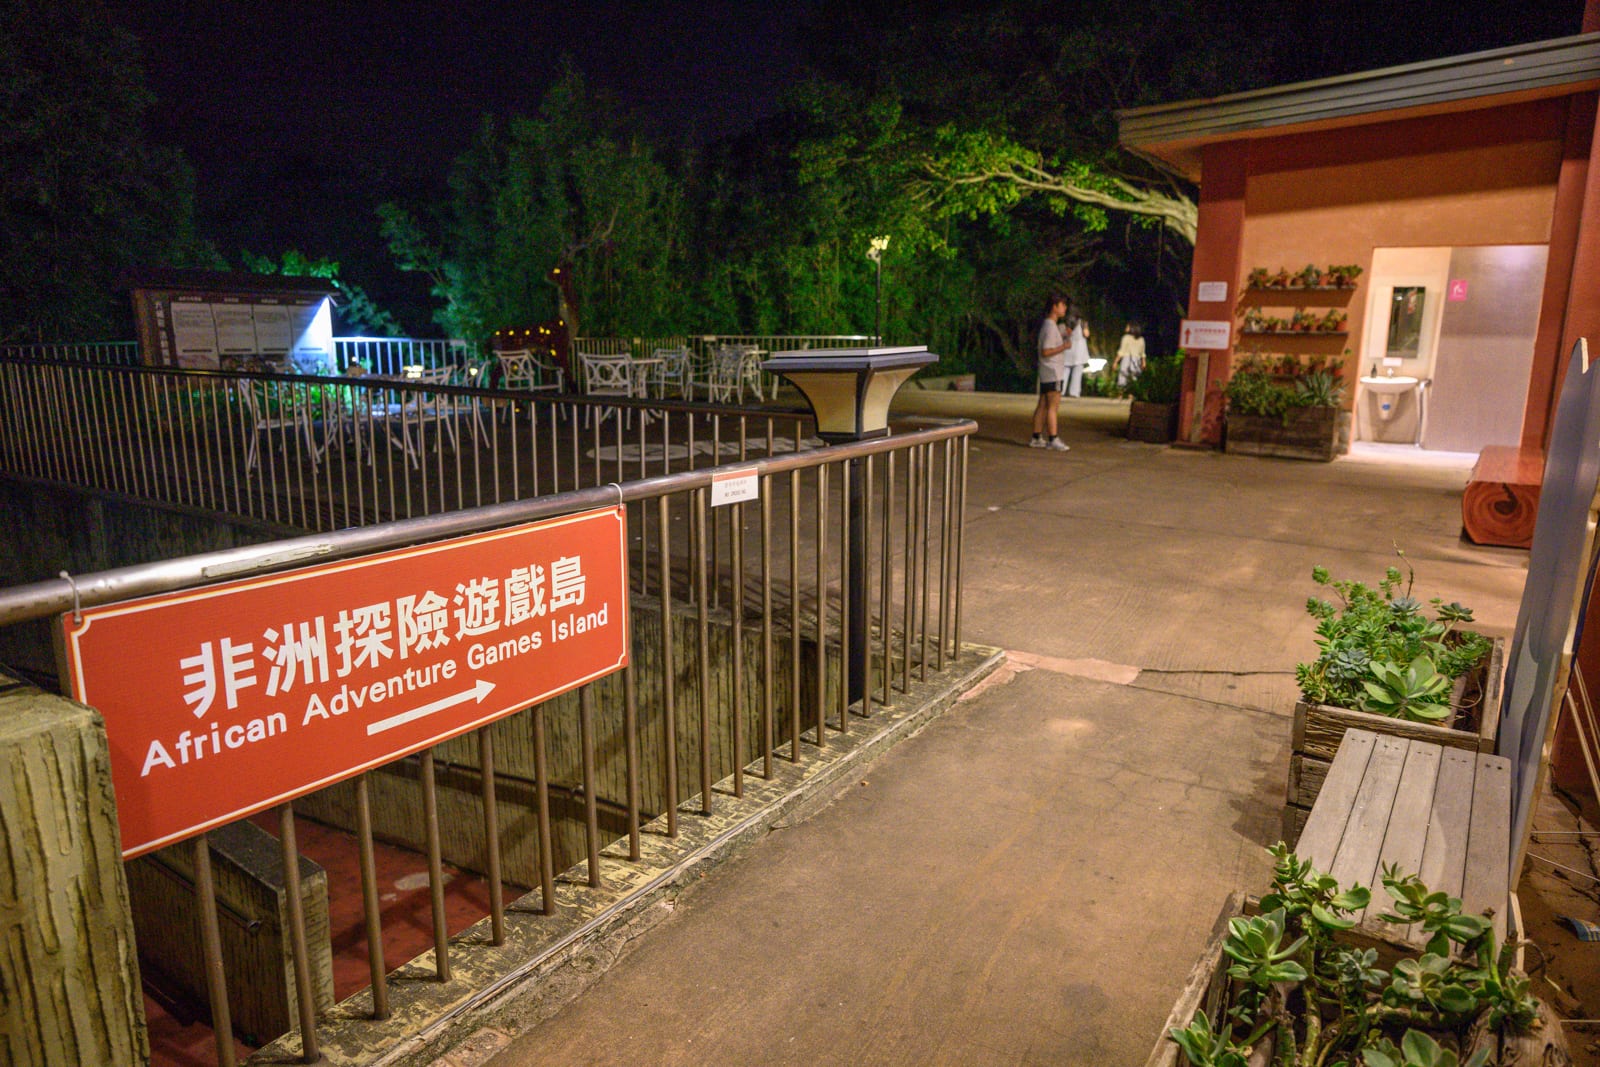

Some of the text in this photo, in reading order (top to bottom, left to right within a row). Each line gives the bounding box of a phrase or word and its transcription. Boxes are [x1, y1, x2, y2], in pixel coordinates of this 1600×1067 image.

[140, 602, 608, 777] African Adventure Games Island
[179, 555, 587, 719] 非洲探險遊戲島
